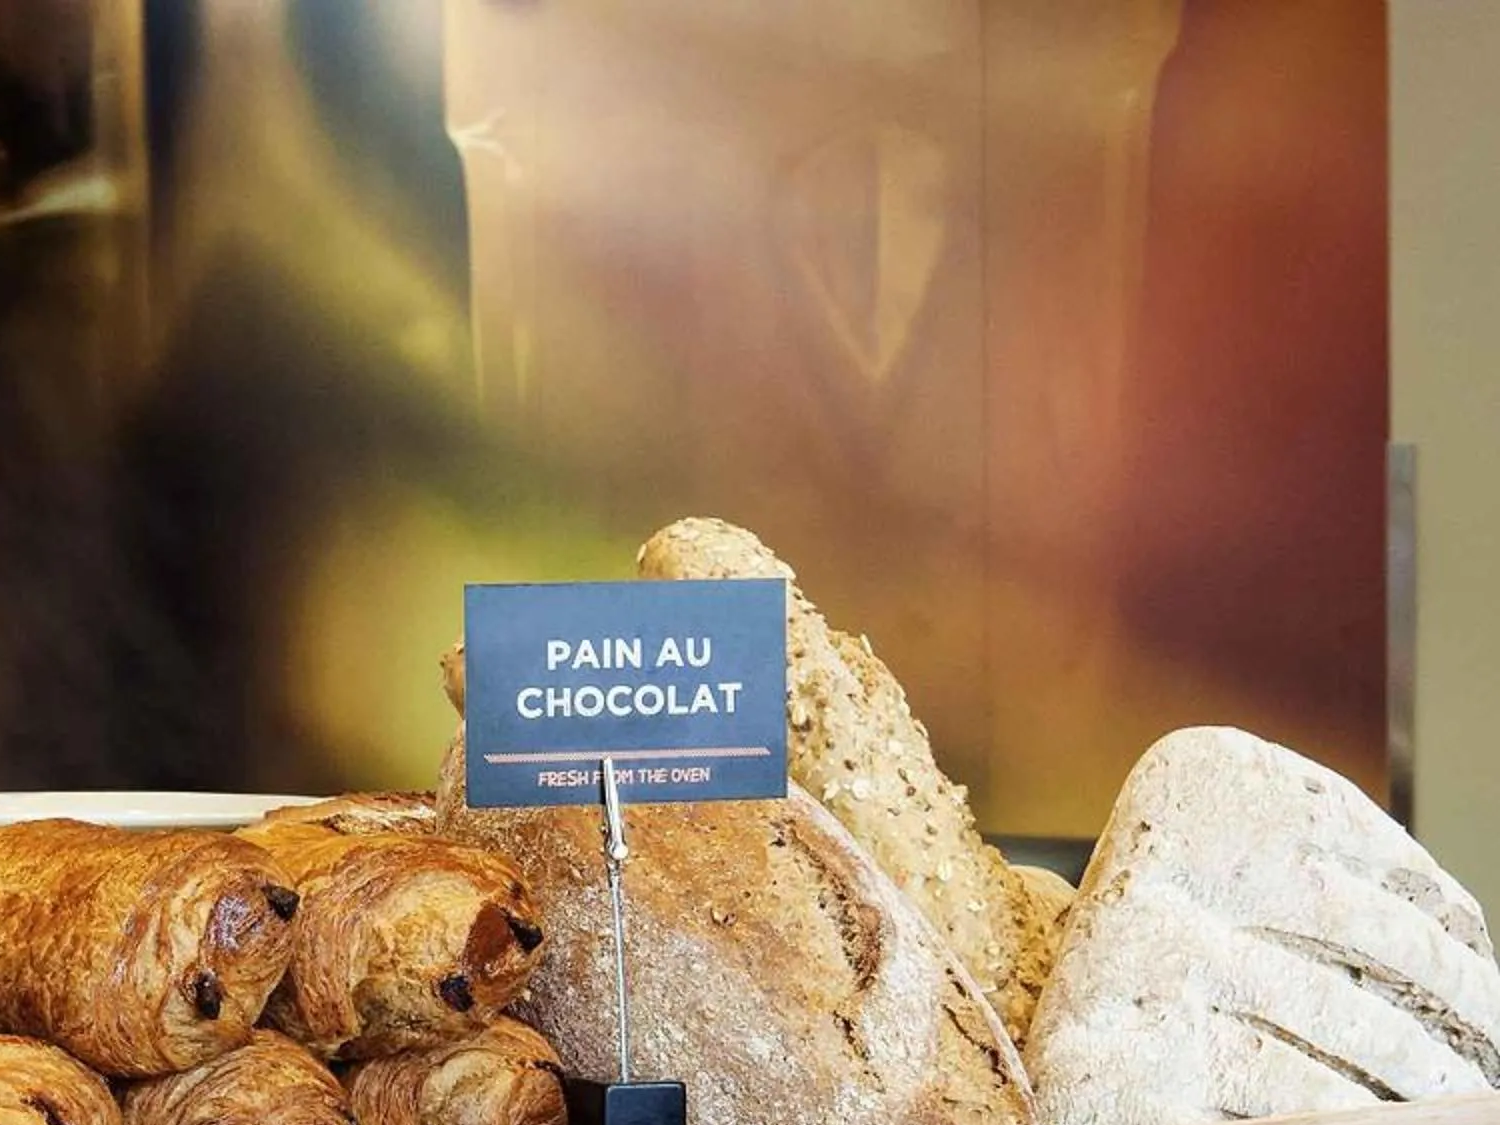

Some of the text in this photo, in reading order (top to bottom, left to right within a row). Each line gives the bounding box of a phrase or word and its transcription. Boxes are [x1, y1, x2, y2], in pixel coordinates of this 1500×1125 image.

[547, 637, 712, 670] PAIN AU
[516, 683, 743, 719] CHOCOLAT
[537, 767, 711, 787] FRESH FOM THE OVEN
